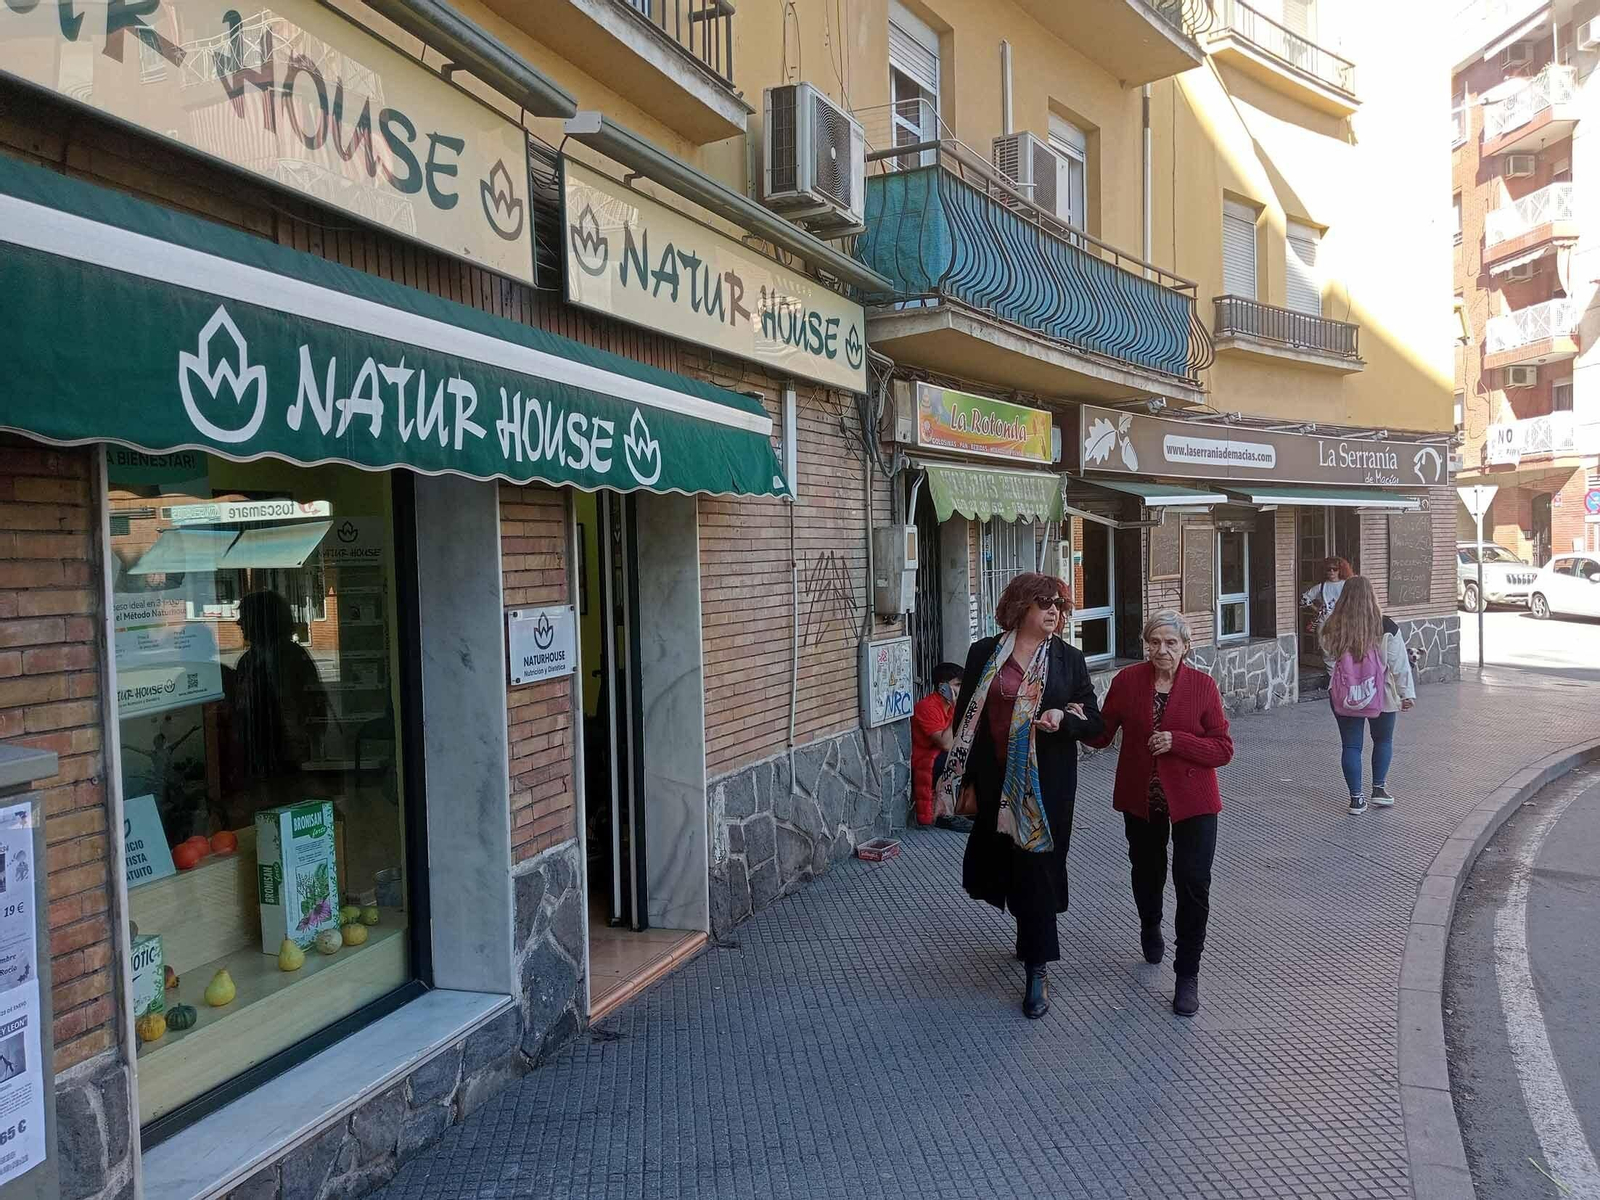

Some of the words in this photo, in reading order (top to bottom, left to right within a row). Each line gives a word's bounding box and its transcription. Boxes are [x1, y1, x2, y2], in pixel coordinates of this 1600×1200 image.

[213, 9, 465, 210] HOUSE
[620, 221, 751, 326] NATUR
[758, 284, 839, 359] HOUSE
[286, 344, 487, 450] NATUR
[496, 386, 615, 474] HOUSE
[950, 403, 967, 432] La
[971, 408, 1027, 441] Rotonda
[1498, 428, 1513, 444] NO
[1166, 443, 1273, 462] www.laserraniademacias.com
[1318, 440, 1337, 467] La
[1339, 442, 1399, 470] Serranía
[1364, 473, 1374, 483] de
[130, 600, 145, 610] ideal
[124, 612, 151, 620] Método
[523, 650, 565, 667] NATURHOUSE
[293, 811, 323, 832] BRONISAN
[4, 905, 15, 918] 19
[17, 901, 24, 913] €
